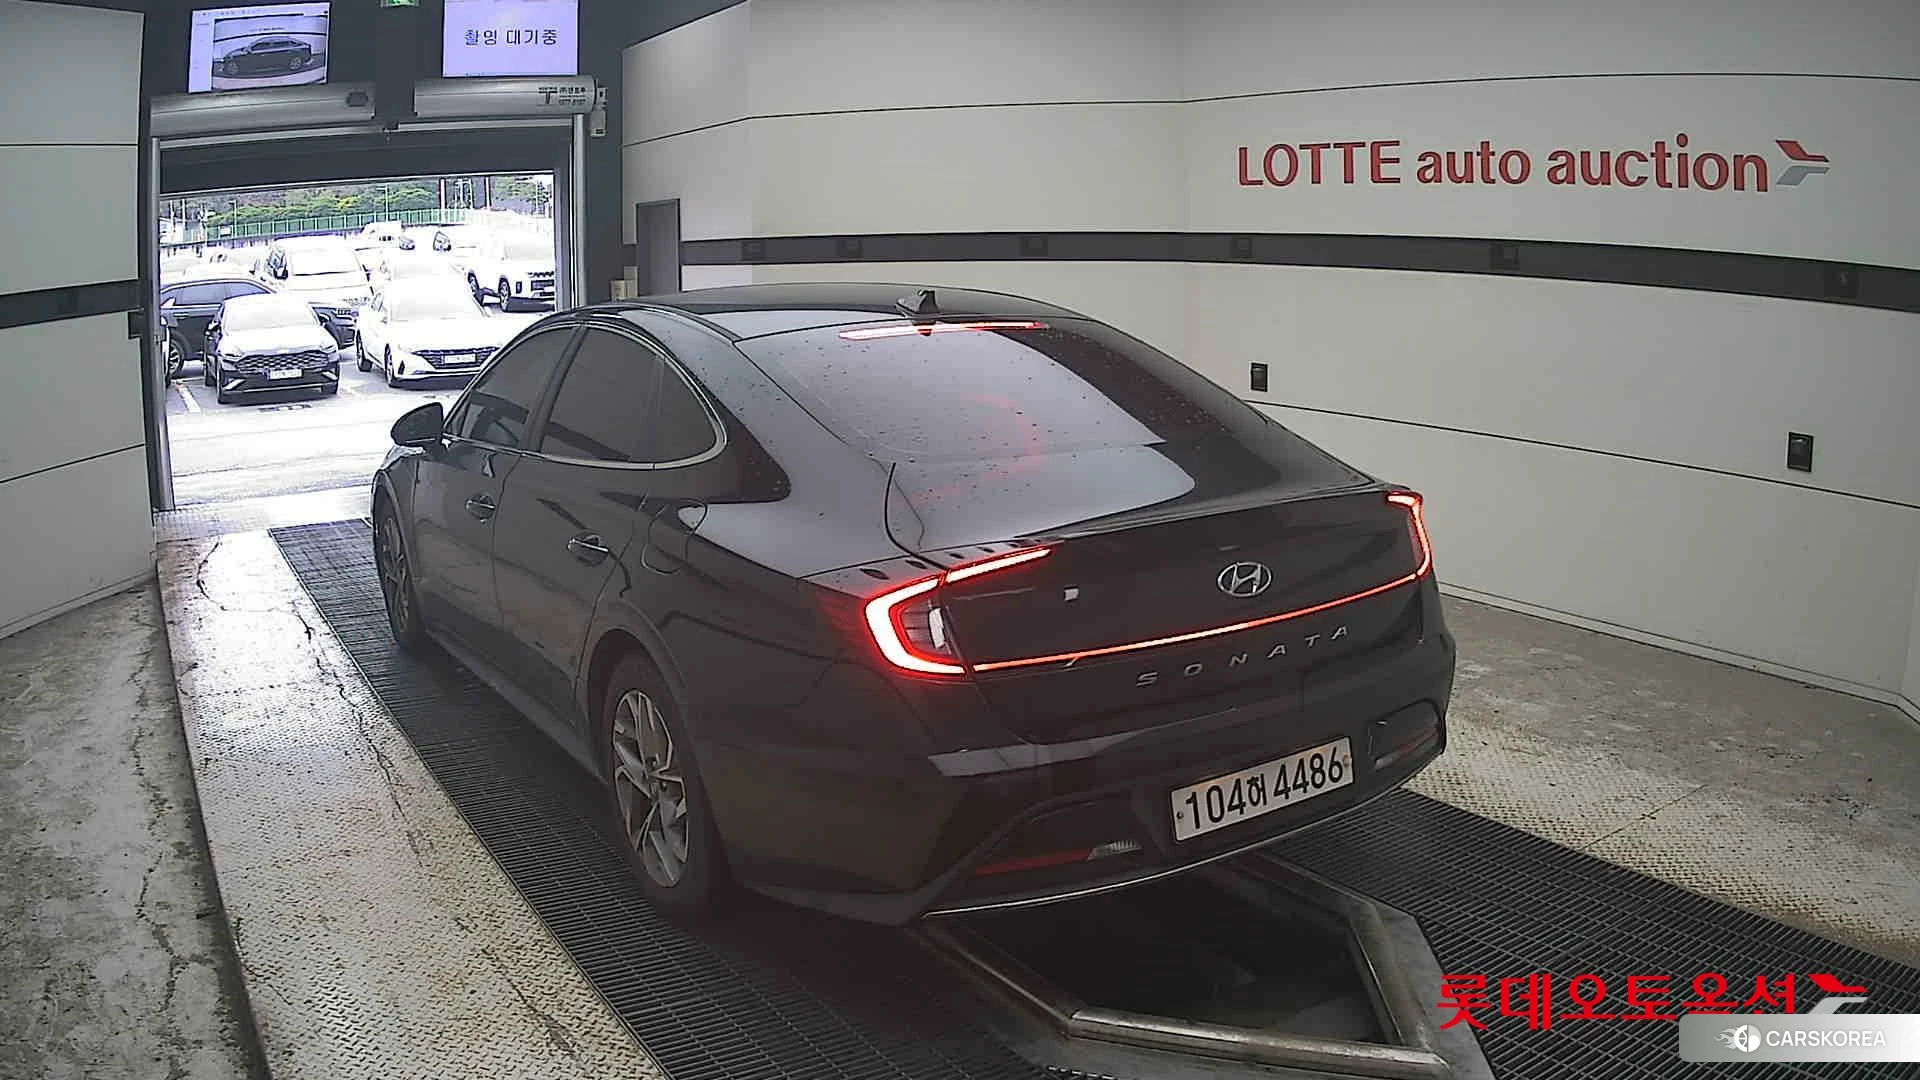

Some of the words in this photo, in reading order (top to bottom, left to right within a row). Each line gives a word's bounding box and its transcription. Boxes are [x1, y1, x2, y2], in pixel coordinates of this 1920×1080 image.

[506, 29, 558, 46] 대기중
[1238, 139, 1401, 186] LOTTE
[1416, 140, 1532, 184] auto
[1547, 133, 1769, 192] auction
[1136, 626, 1349, 687] SONATA
